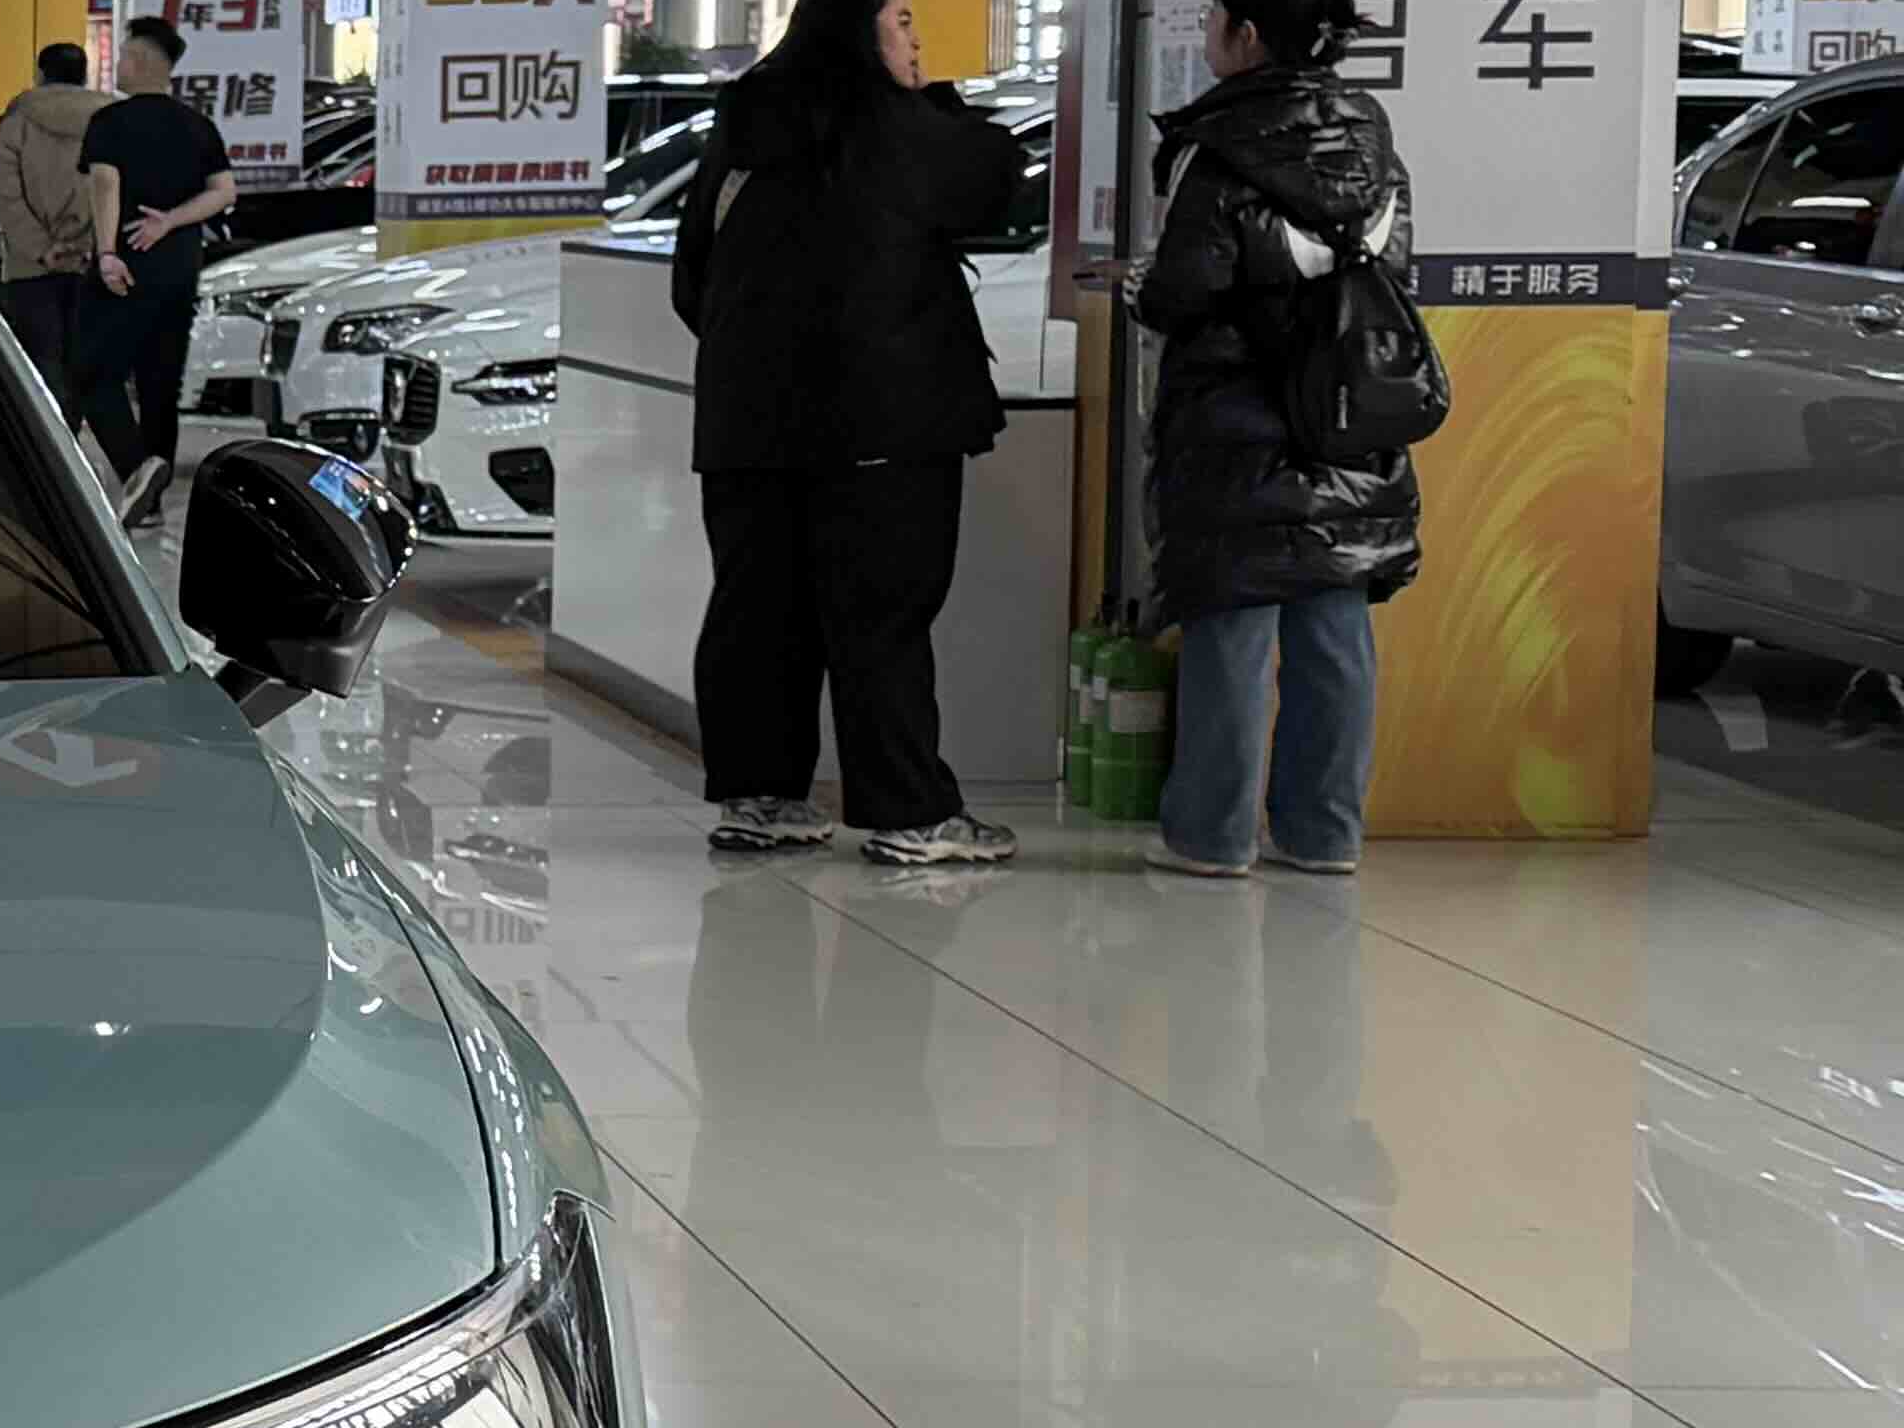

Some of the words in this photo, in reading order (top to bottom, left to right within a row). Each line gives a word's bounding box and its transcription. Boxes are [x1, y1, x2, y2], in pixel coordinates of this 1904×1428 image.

[1808, 28, 1897, 73] 回购
[170, 72, 277, 118] 保修
[439, 49, 581, 124] 回购
[1450, 263, 1603, 299] 精于服务
